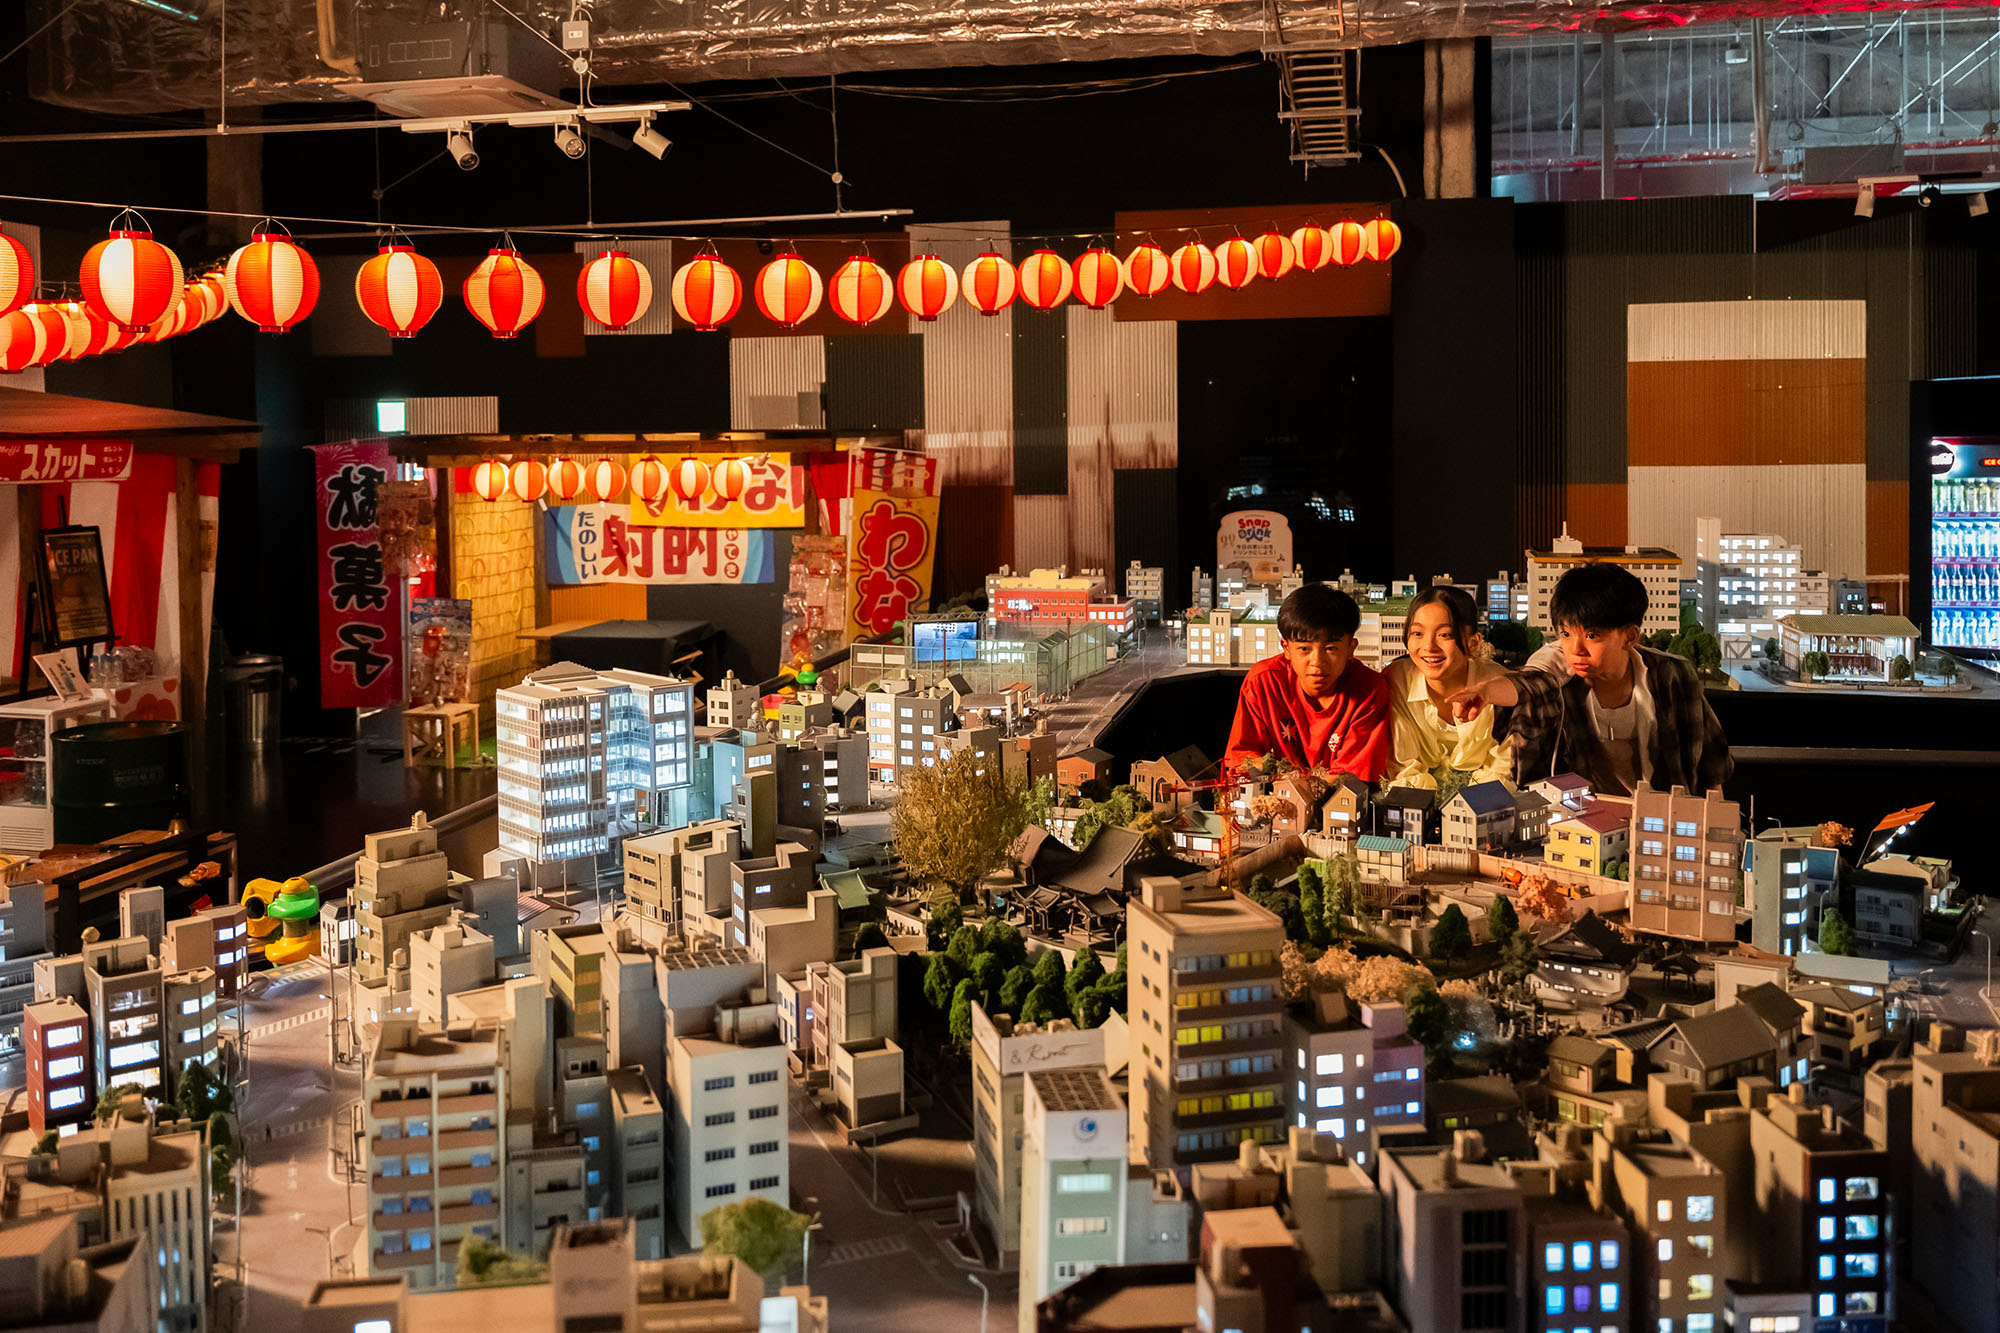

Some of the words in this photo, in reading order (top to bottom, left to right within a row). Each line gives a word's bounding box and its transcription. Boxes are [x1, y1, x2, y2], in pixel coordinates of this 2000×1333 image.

[21, 444, 96, 480] スカット
[577, 511, 597, 579] たのしい
[601, 514, 717, 577] 射的
[1238, 519, 1270, 528] Snap
[72, 547, 97, 563] PAN
[854, 500, 929, 645] わな
